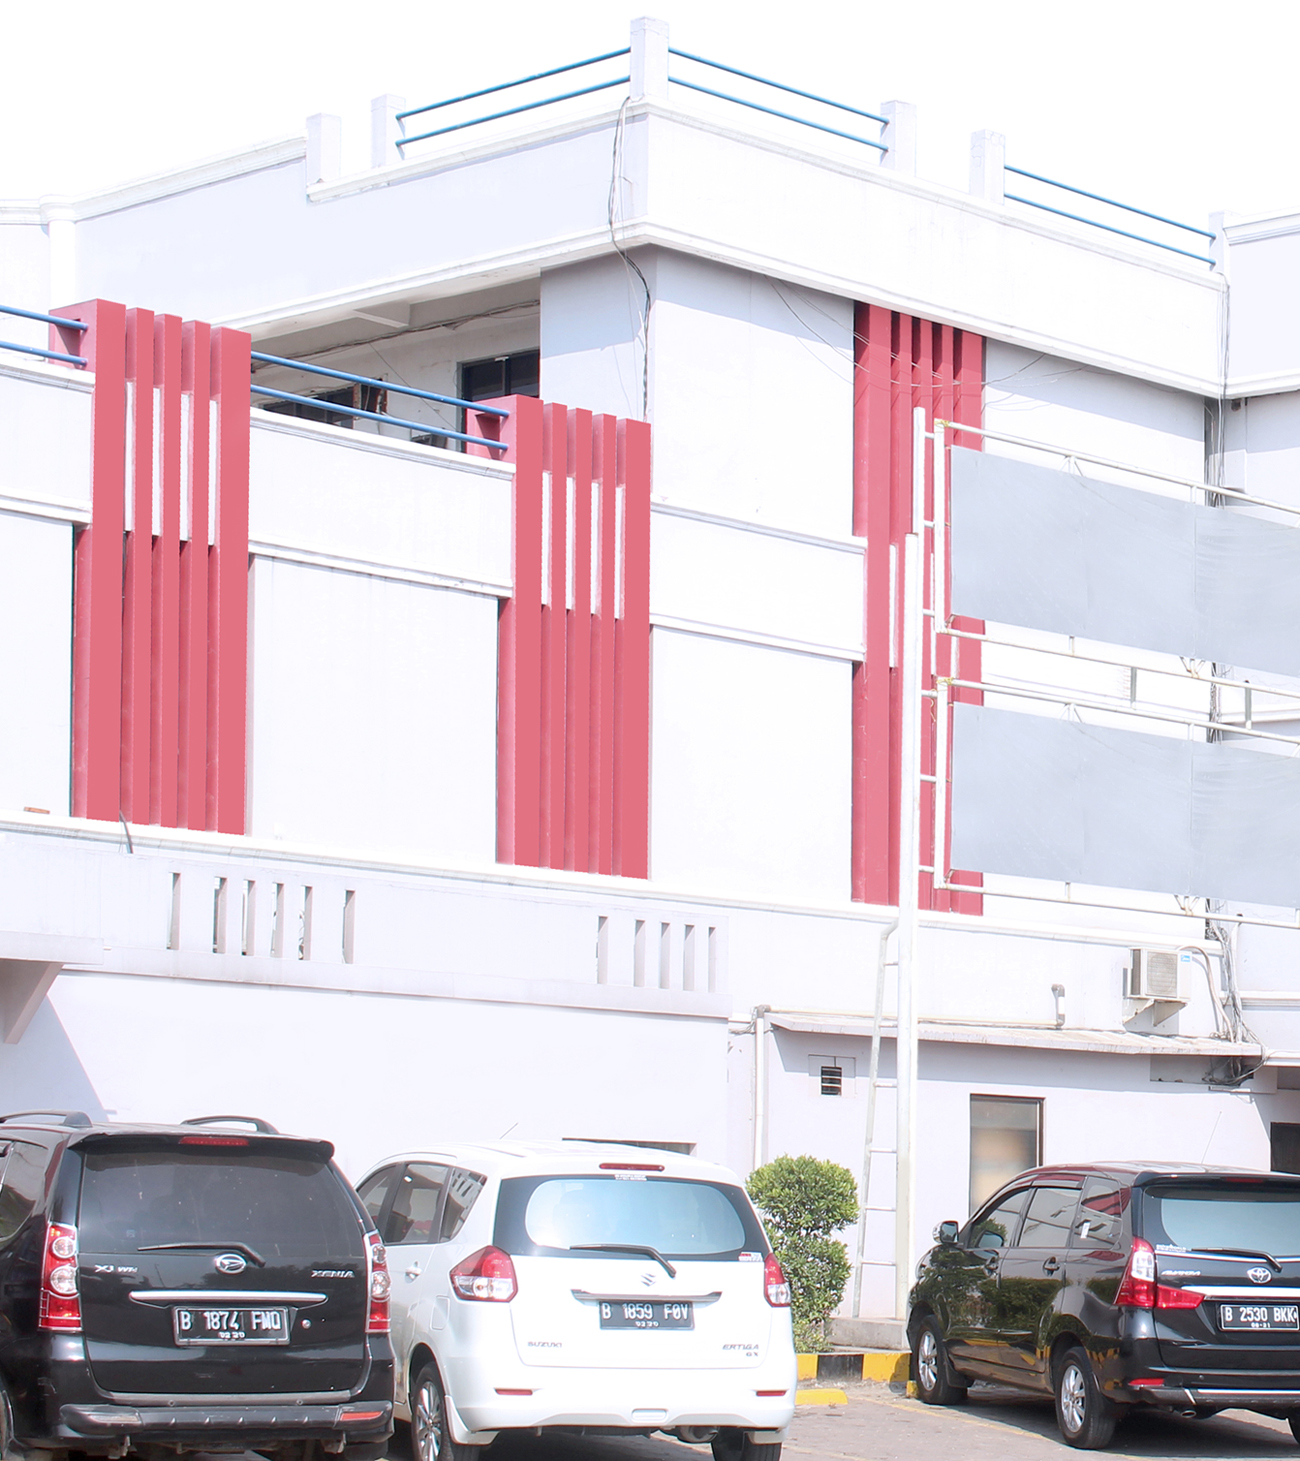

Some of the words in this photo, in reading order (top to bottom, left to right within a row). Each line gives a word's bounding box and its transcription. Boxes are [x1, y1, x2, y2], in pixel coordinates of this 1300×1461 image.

[310, 1269, 355, 1279] XENIA
[601, 1302, 612, 1320] B
[622, 1302, 653, 1320] 1859
[1225, 1307, 1233, 1322] B
[1239, 1307, 1268, 1322] 2530
[1273, 1307, 1296, 1322] BKK
[180, 1311, 192, 1331] B
[203, 1311, 240, 1331] 1874
